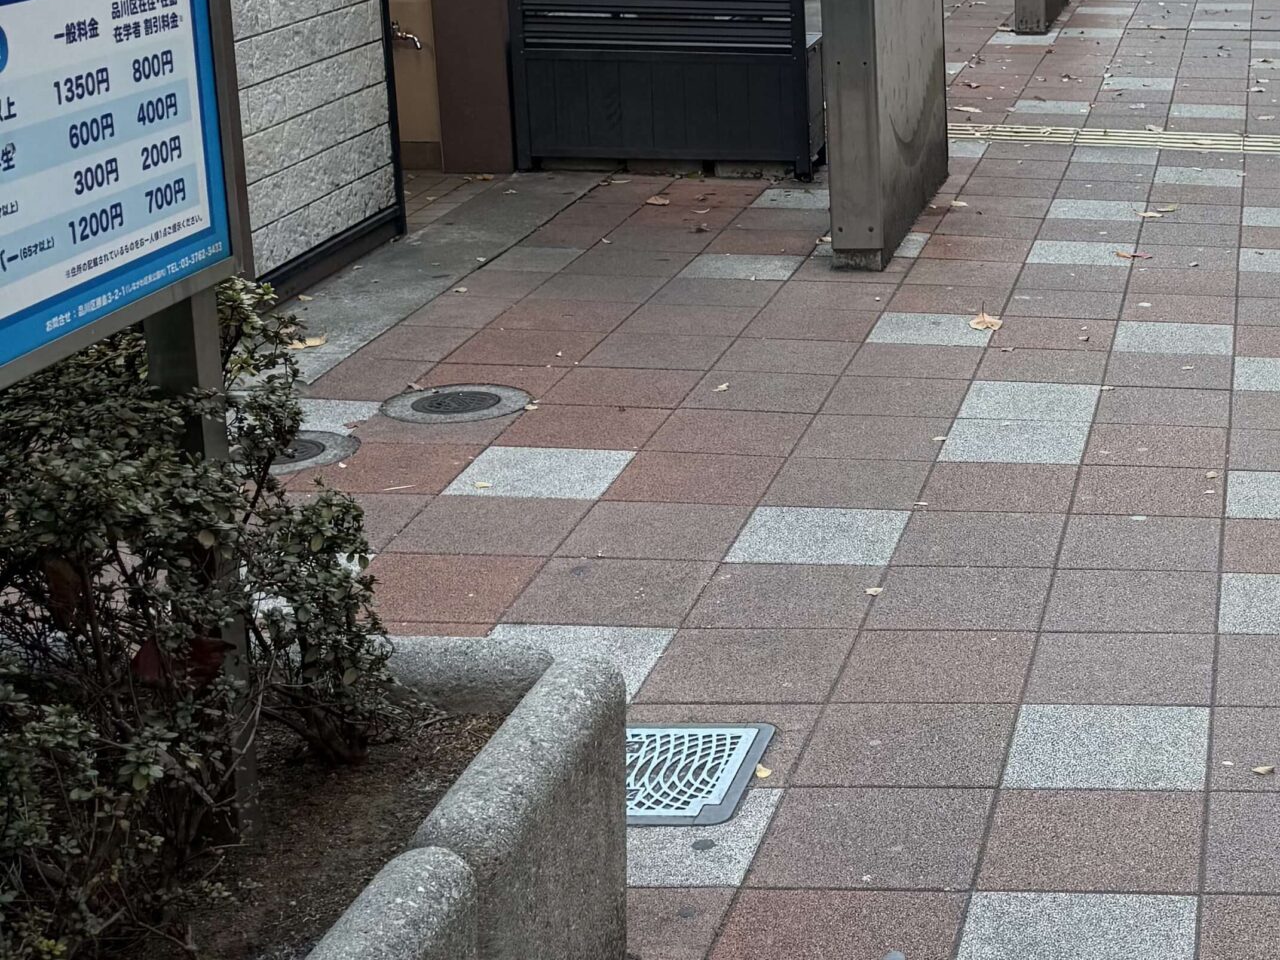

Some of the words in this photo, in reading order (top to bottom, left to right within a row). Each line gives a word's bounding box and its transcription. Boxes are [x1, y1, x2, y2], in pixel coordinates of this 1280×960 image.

[54, 17, 100, 45] 一般料金
[112, 21, 141, 43] 在学者
[132, 49, 174, 83] 800円
[54, 67, 110, 105] 1350円
[137, 92, 178, 127] 400円
[69, 112, 115, 149] 600円
[141, 135, 182, 171] 200円
[73, 157, 119, 196] 300円
[145, 177, 186, 214] 700円
[68, 202, 124, 245] 1200円
